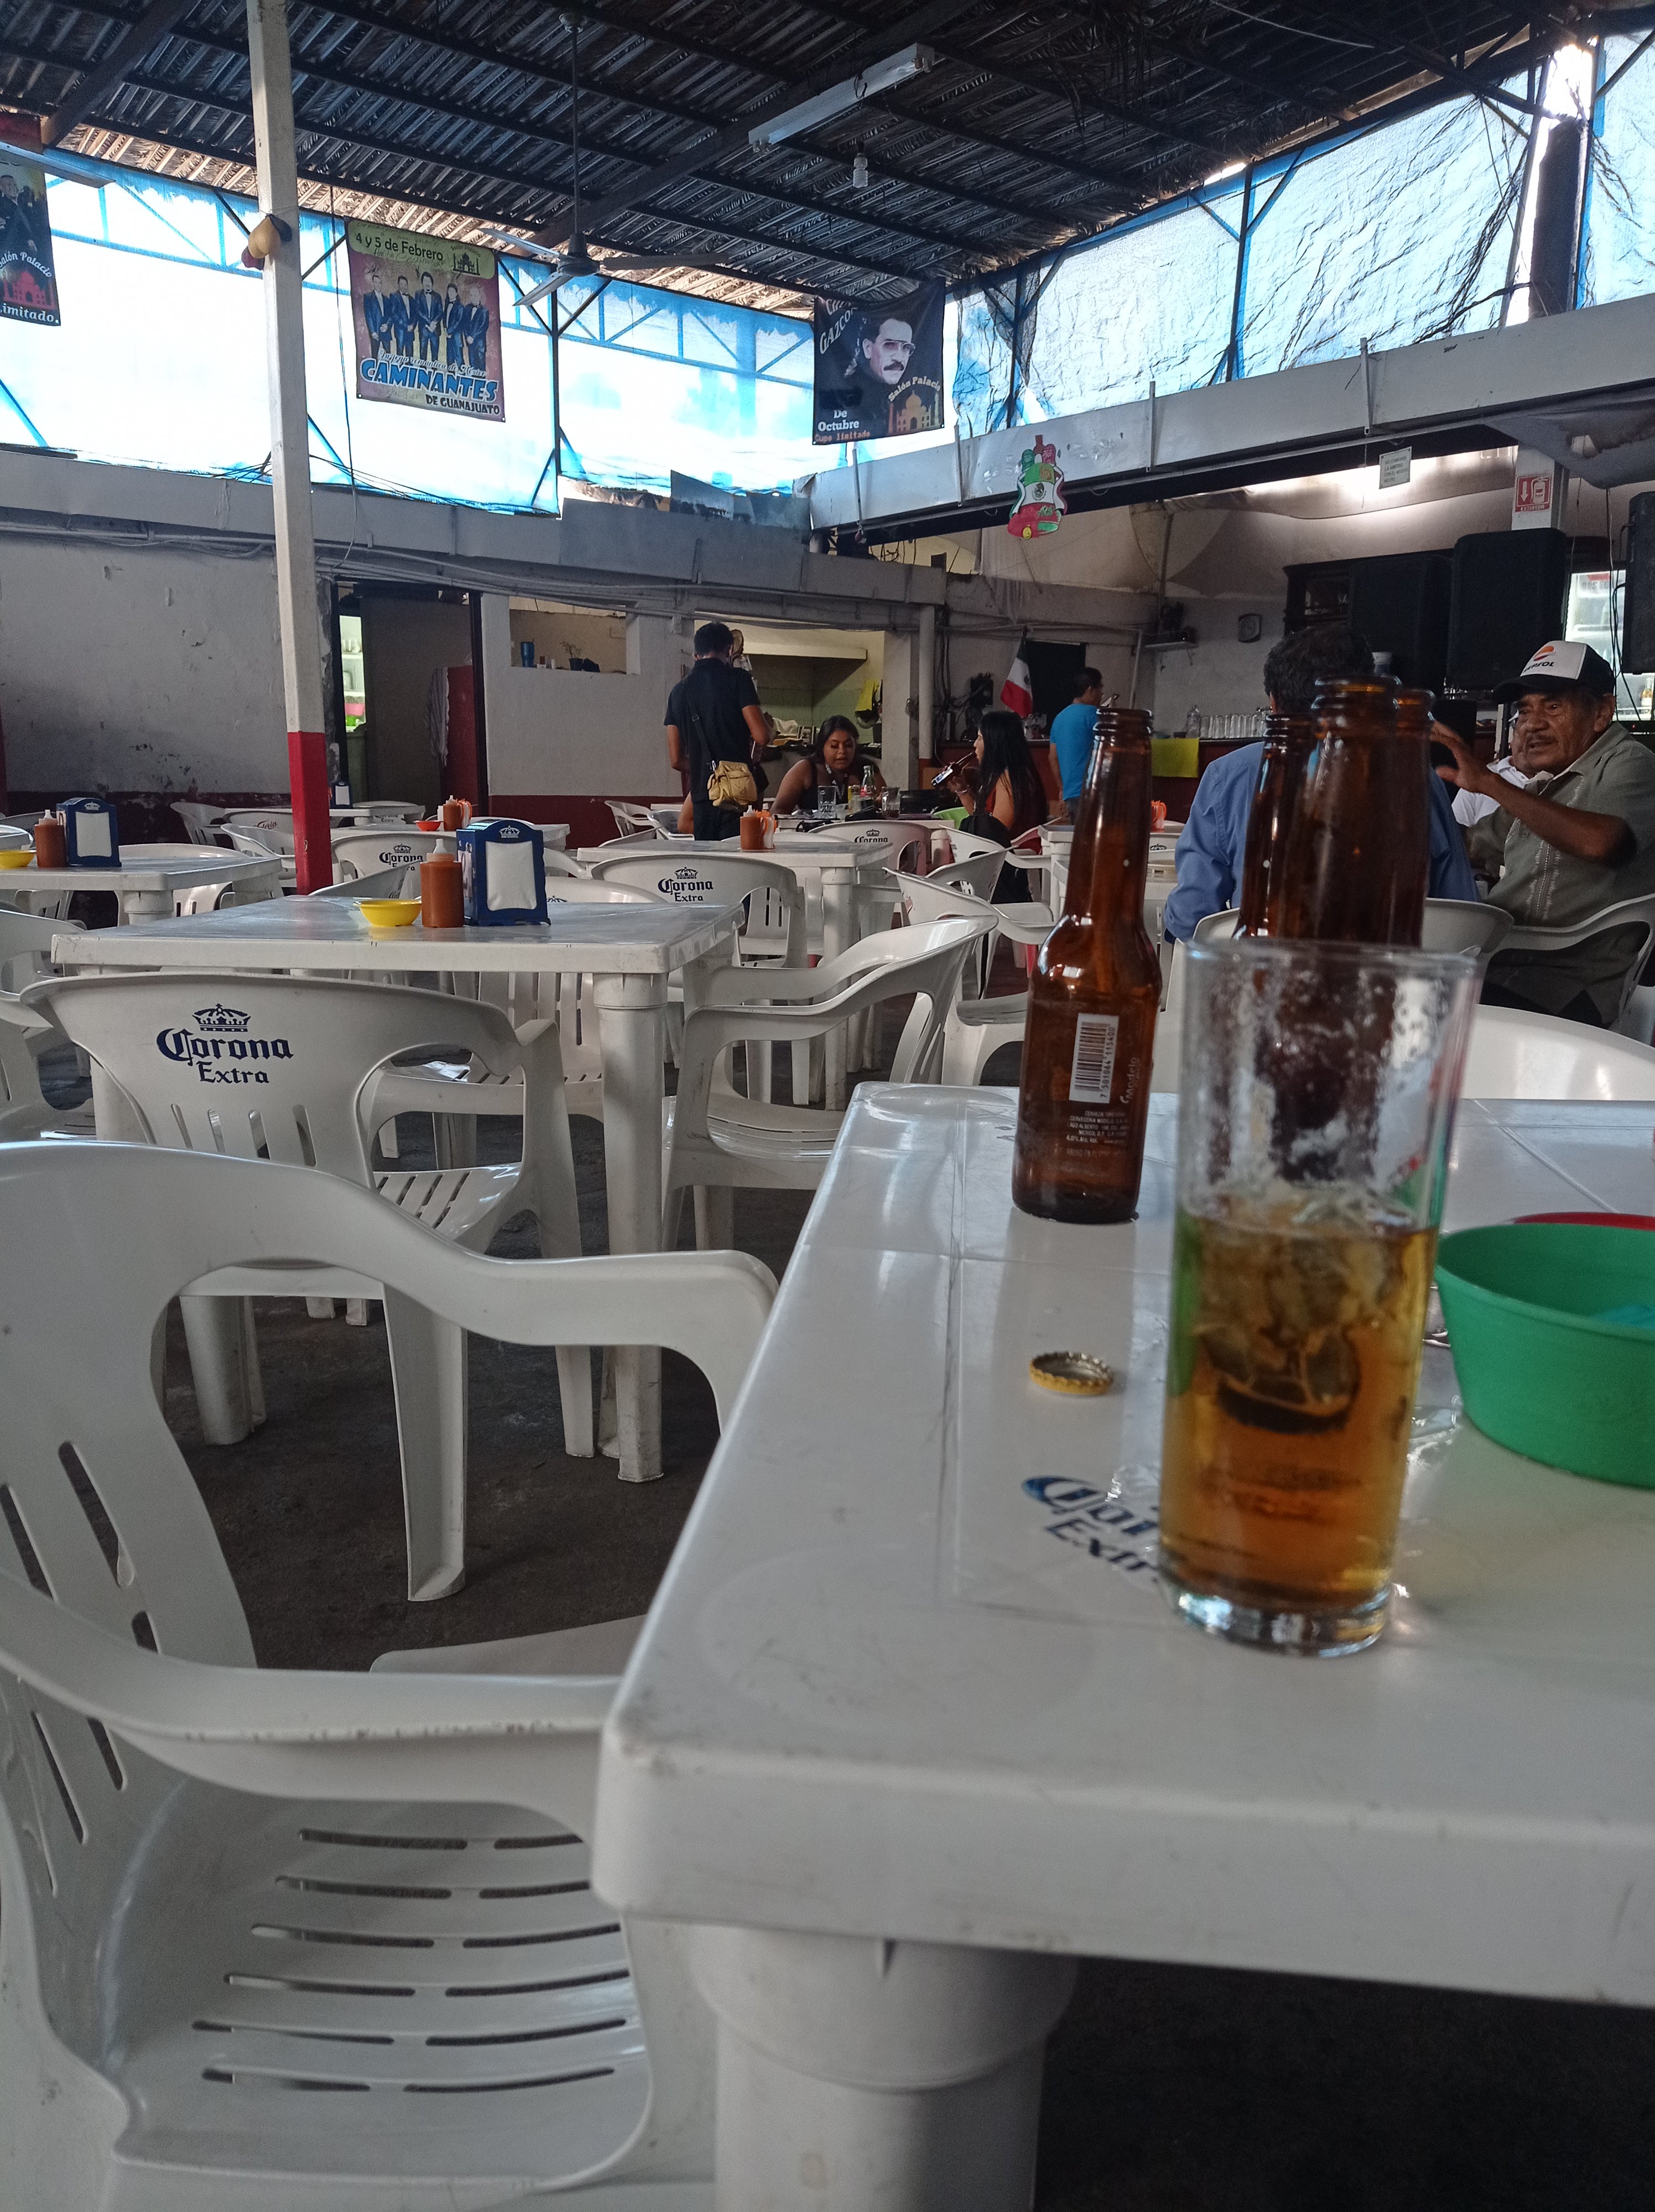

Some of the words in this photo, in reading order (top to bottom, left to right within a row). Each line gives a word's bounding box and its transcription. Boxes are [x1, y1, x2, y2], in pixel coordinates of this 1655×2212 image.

[356, 233, 362, 244] 4
[365, 237, 372, 248] y
[375, 237, 381, 248] 5
[385, 238, 399, 251] de
[402, 241, 443, 261] Febrero
[20, 252, 52, 277] Palacio
[360, 358, 499, 403] CAMINANTES
[888, 380, 911, 402] Salón
[912, 375, 940, 392] Palacio
[425, 394, 438, 406] DE
[440, 398, 500, 415] GUANAJUATO
[834, 409, 847, 419] De
[818, 419, 860, 432] Octubre
[814, 433, 832, 443] Cupo
[379, 852, 424, 865] Corona
[392, 863, 415, 871] Era
[658, 878, 714, 895] Corona
[674, 892, 704, 902] Extra
[156, 1028, 294, 1066] Corona
[196, 1061, 270, 1083] Extra
[1101, 1061, 1111, 1089] 501064
